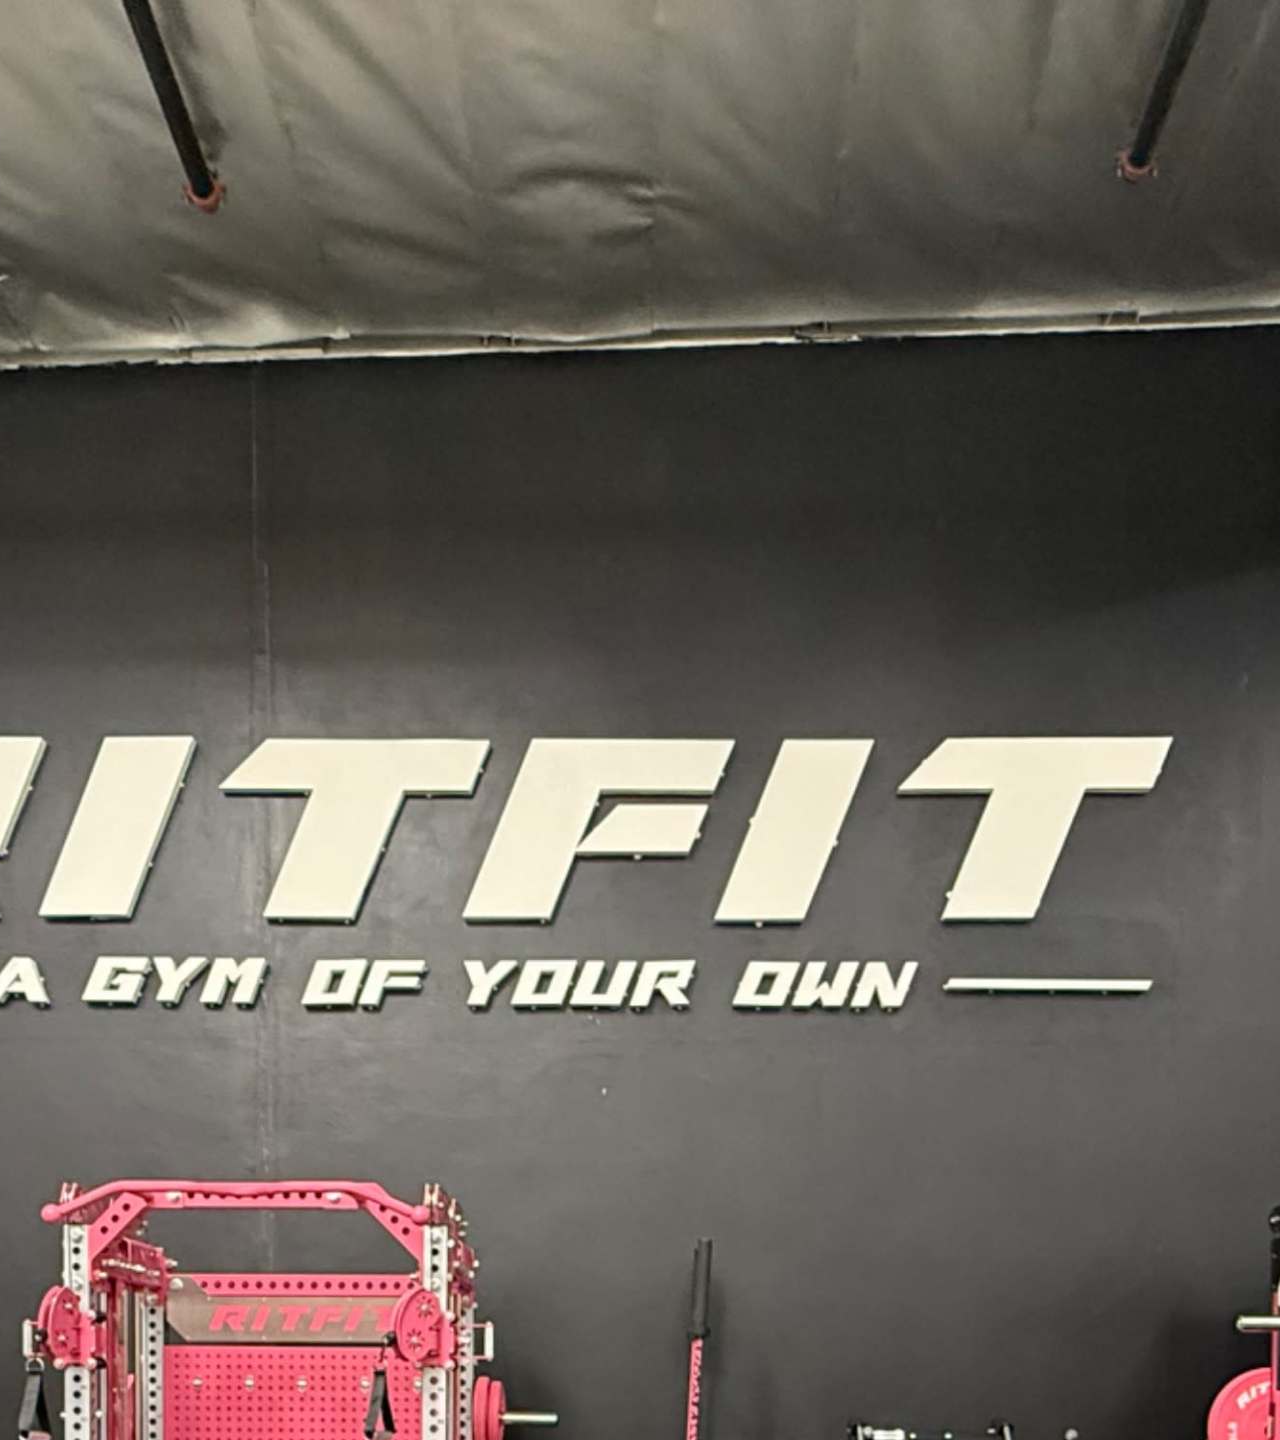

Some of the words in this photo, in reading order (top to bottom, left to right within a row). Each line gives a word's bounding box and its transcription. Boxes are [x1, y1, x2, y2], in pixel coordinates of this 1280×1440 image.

[81, 956, 269, 1007] GYM
[301, 958, 429, 1008] OF
[463, 959, 697, 1010] YOUR
[732, 960, 919, 1010] OWN
[209, 1304, 394, 1332] RITFIT
